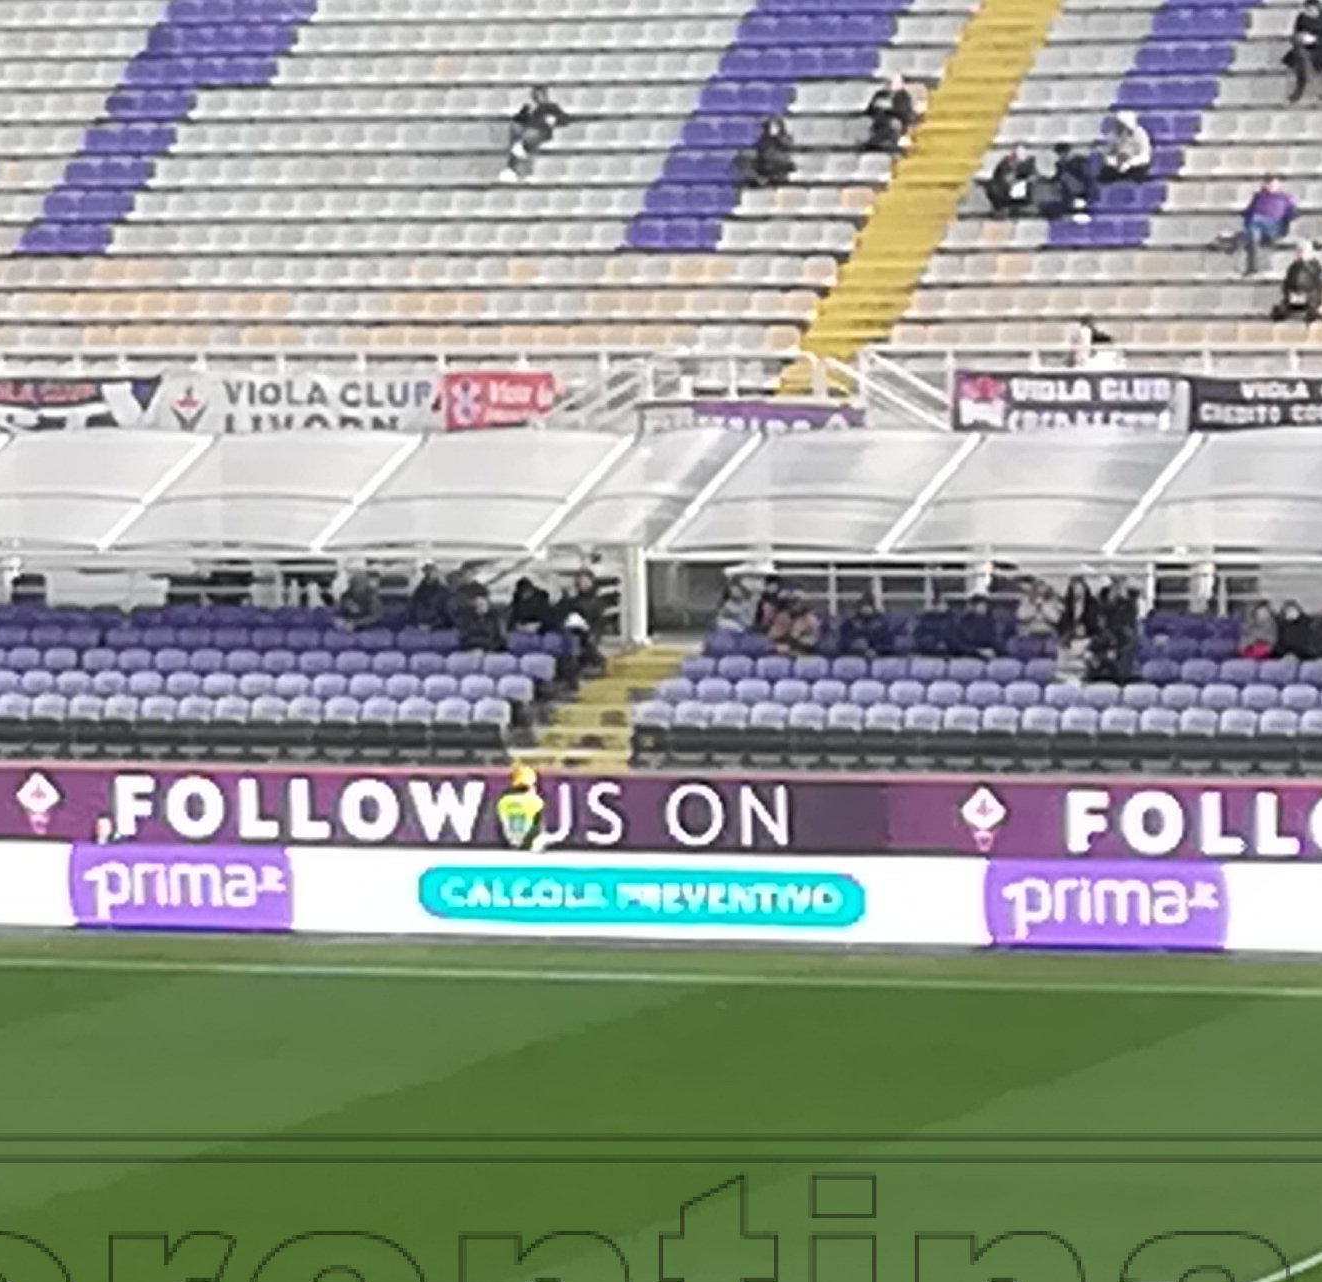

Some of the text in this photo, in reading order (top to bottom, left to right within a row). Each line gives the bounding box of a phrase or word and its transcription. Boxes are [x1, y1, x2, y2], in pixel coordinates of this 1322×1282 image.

[223, 380, 329, 405] VIOLA
[1009, 376, 1092, 402] VIOLA
[1241, 380, 1310, 400] VIOLA
[114, 774, 485, 842] FOLLOW
[665, 783, 790, 847] ON
